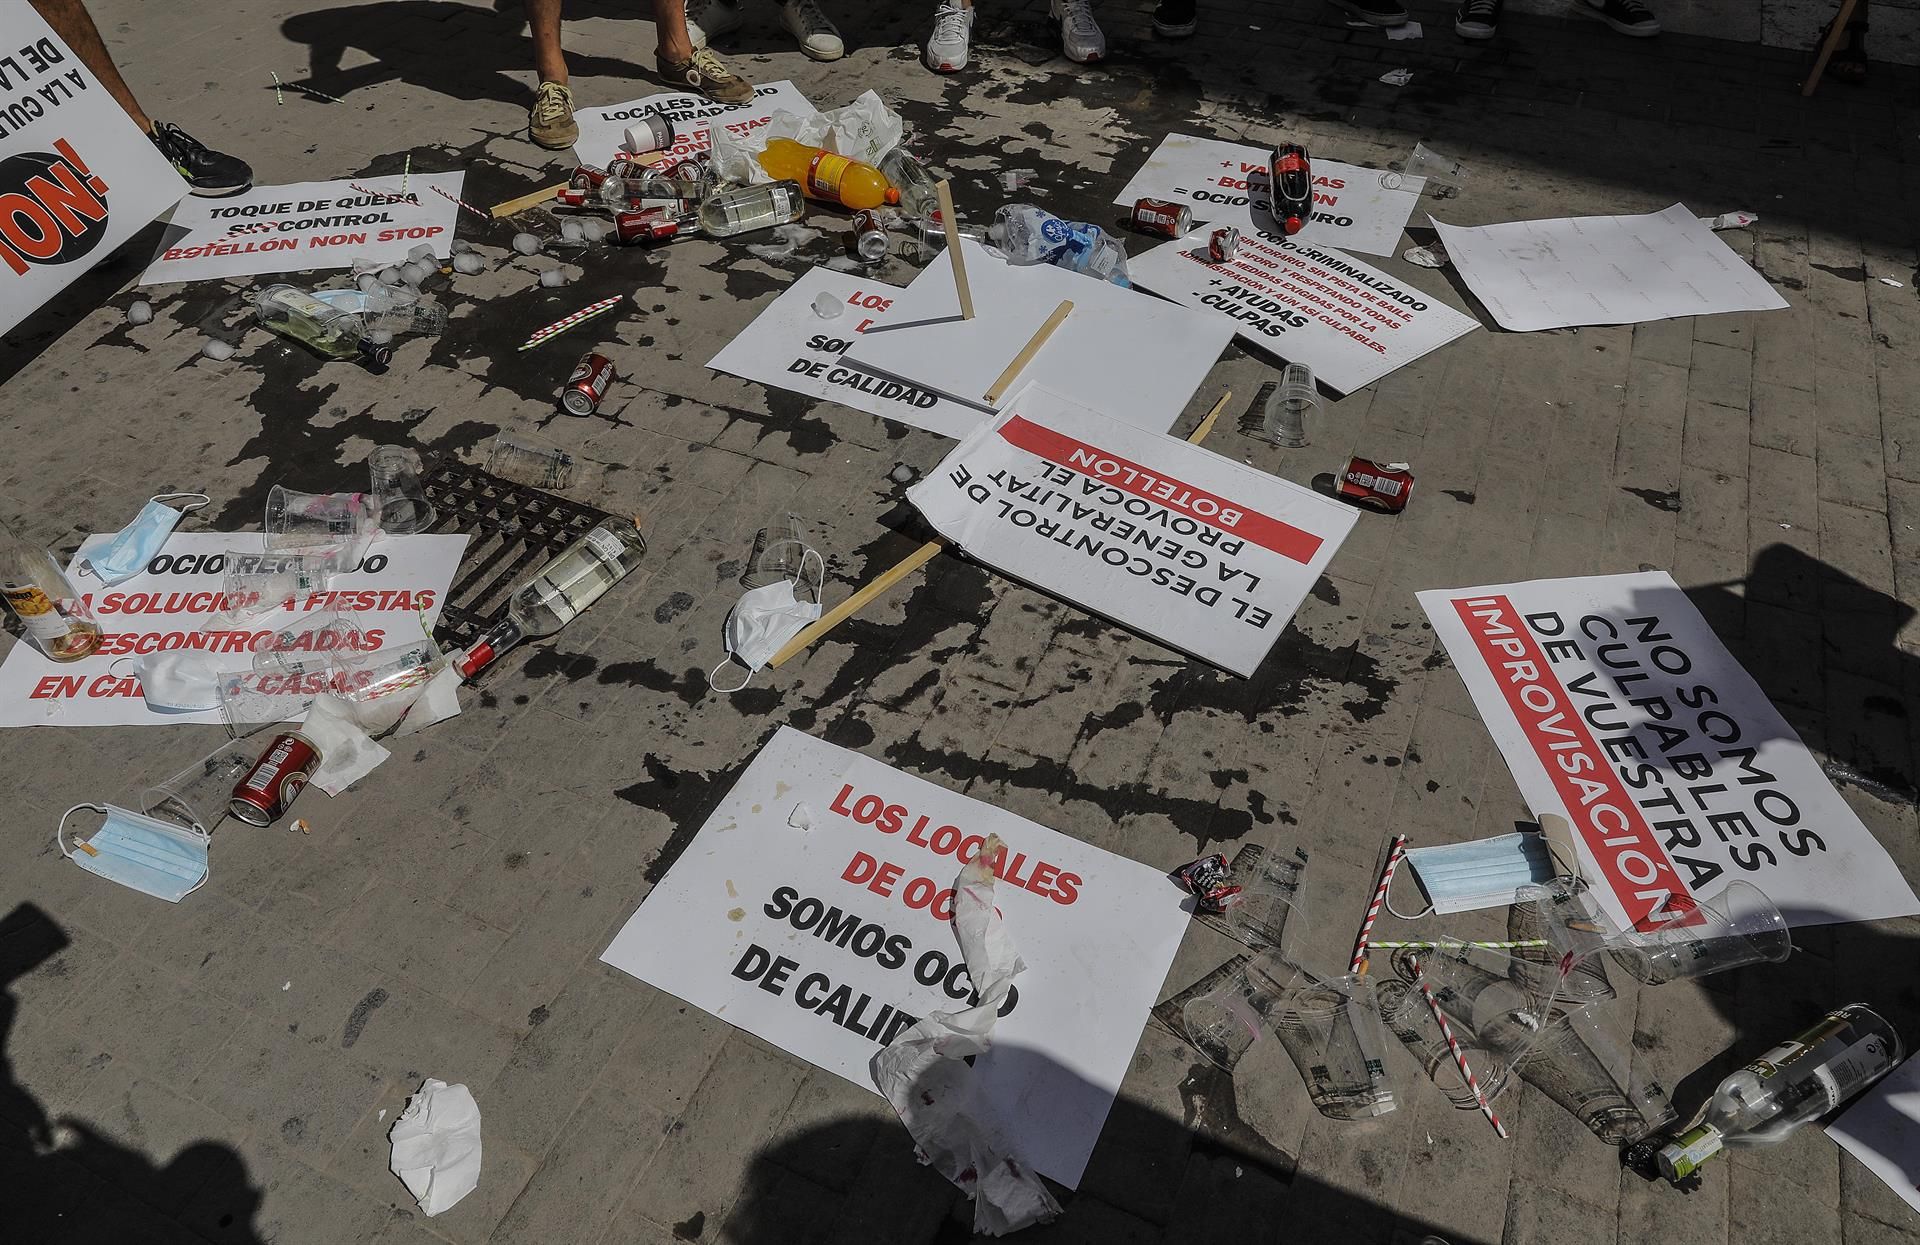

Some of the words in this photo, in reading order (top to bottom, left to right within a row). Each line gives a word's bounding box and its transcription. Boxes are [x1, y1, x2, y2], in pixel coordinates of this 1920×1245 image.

[19, 37, 65, 74] DE
[64, 68, 87, 90] A
[36, 78, 73, 106] LA
[601, 98, 694, 122] LOCALES
[210, 202, 293, 219] TOQUE
[297, 199, 331, 213] DE
[336, 192, 418, 210] QUEDA
[1191, 190, 1251, 206] OCIO
[163, 238, 299, 261] BOTELLÓN
[309, 233, 367, 248] NON
[376, 226, 444, 242] STOP
[278, 212, 394, 232] CONTROL
[1239, 235, 1258, 246] SIN
[1256, 244, 1306, 269] HORARIO,
[1307, 266, 1329, 278] SIN
[1327, 275, 1361, 294] PISTA
[1359, 291, 1379, 303] DE
[1376, 298, 1415, 322] BAILE,
[1241, 251, 1279, 269] AFORO
[1288, 271, 1362, 309] RESPETANDO
[1361, 306, 1401, 330] TODAS
[1256, 230, 1298, 250] OCIO
[1296, 247, 1428, 311] CRIMINALIZADO
[847, 291, 893, 313] LOS
[1177, 250, 1267, 290] ADMINISTRACIÓN
[1318, 315, 1387, 355] CULPABLES.
[1219, 285, 1309, 328] AYUDAS
[1233, 261, 1283, 285] MEDIDAS
[1281, 282, 1335, 309] EXIGIDAS
[1333, 307, 1361, 324] POR
[1359, 321, 1377, 333] LA
[787, 358, 827, 379] DE
[826, 368, 938, 410] CALIDAD
[949, 464, 991, 504] DE
[1041, 461, 1076, 486] EL
[1069, 448, 1243, 528] BOTELLÓN
[987, 470, 1208, 569] GENERALITAT
[1082, 478, 1245, 557] PROVOCA
[147, 554, 225, 575] OCIO
[998, 499, 1222, 608] DESCONTROL
[1218, 561, 1261, 593] LA
[302, 590, 436, 612] FIESTAS
[1231, 597, 1273, 629] EL
[29, 675, 86, 699] EN
[1525, 611, 1584, 664] DE
[1568, 671, 1725, 892] VUESTRA
[1579, 614, 1777, 872] CULPABLES
[1625, 615, 1692, 675] NO
[1676, 685, 1827, 858] SOMOS
[1466, 598, 1687, 925] IMPROVISACIÓN
[829, 783, 908, 835] LOS
[840, 851, 906, 898] DE
[763, 886, 912, 970] SOMOS
[731, 943, 800, 997] DE
